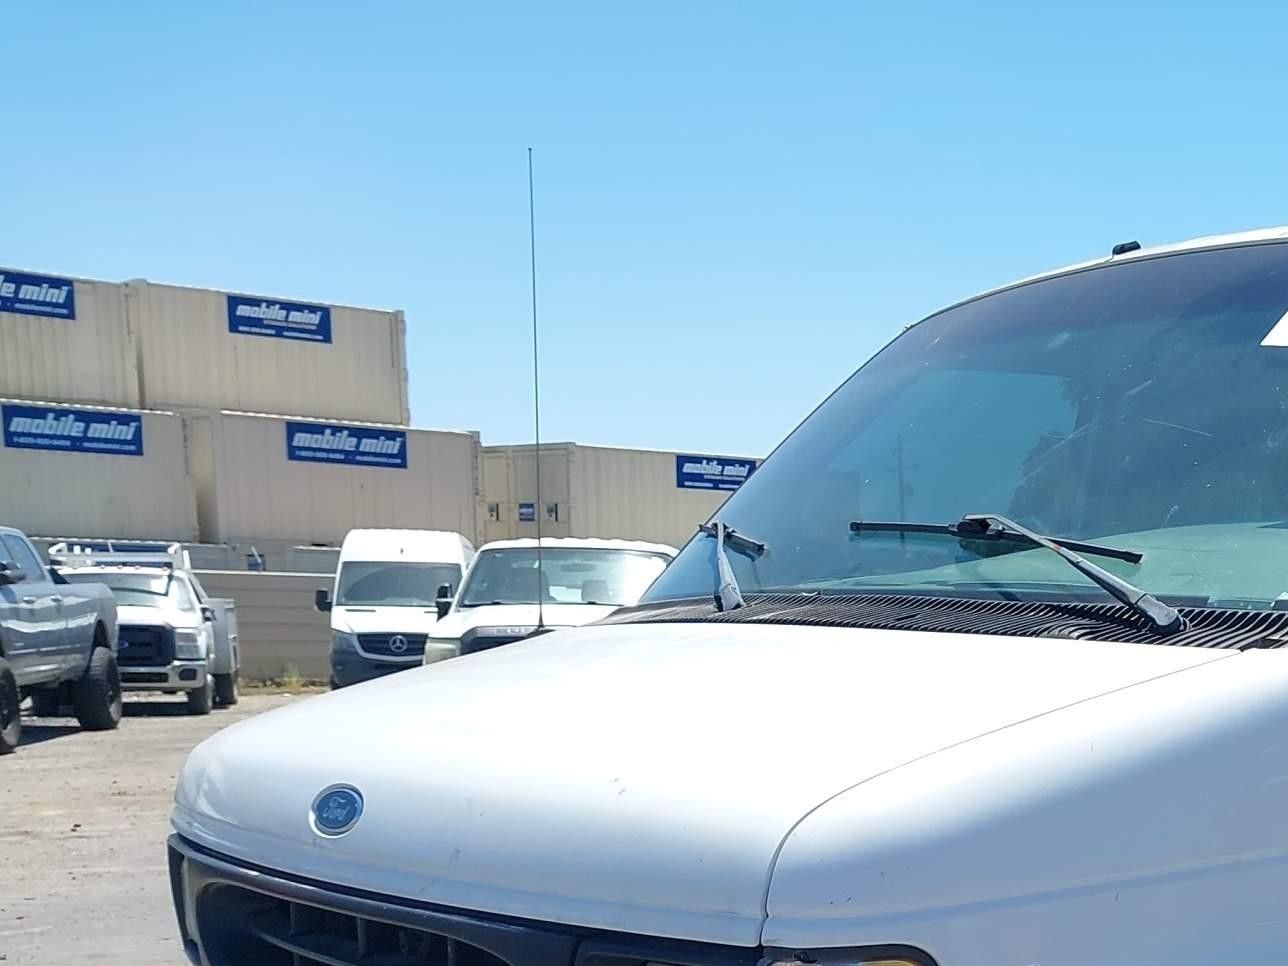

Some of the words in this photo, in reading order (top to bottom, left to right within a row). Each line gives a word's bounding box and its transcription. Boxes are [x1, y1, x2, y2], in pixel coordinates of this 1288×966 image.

[18, 283, 71, 304] mini
[235, 302, 287, 321] mobile
[287, 309, 322, 325] mini
[9, 412, 85, 437] mobile
[87, 420, 139, 440] mini
[292, 428, 358, 451] mobile
[359, 436, 403, 454] mini
[682, 460, 722, 474] mobile
[723, 464, 750, 476] mini
